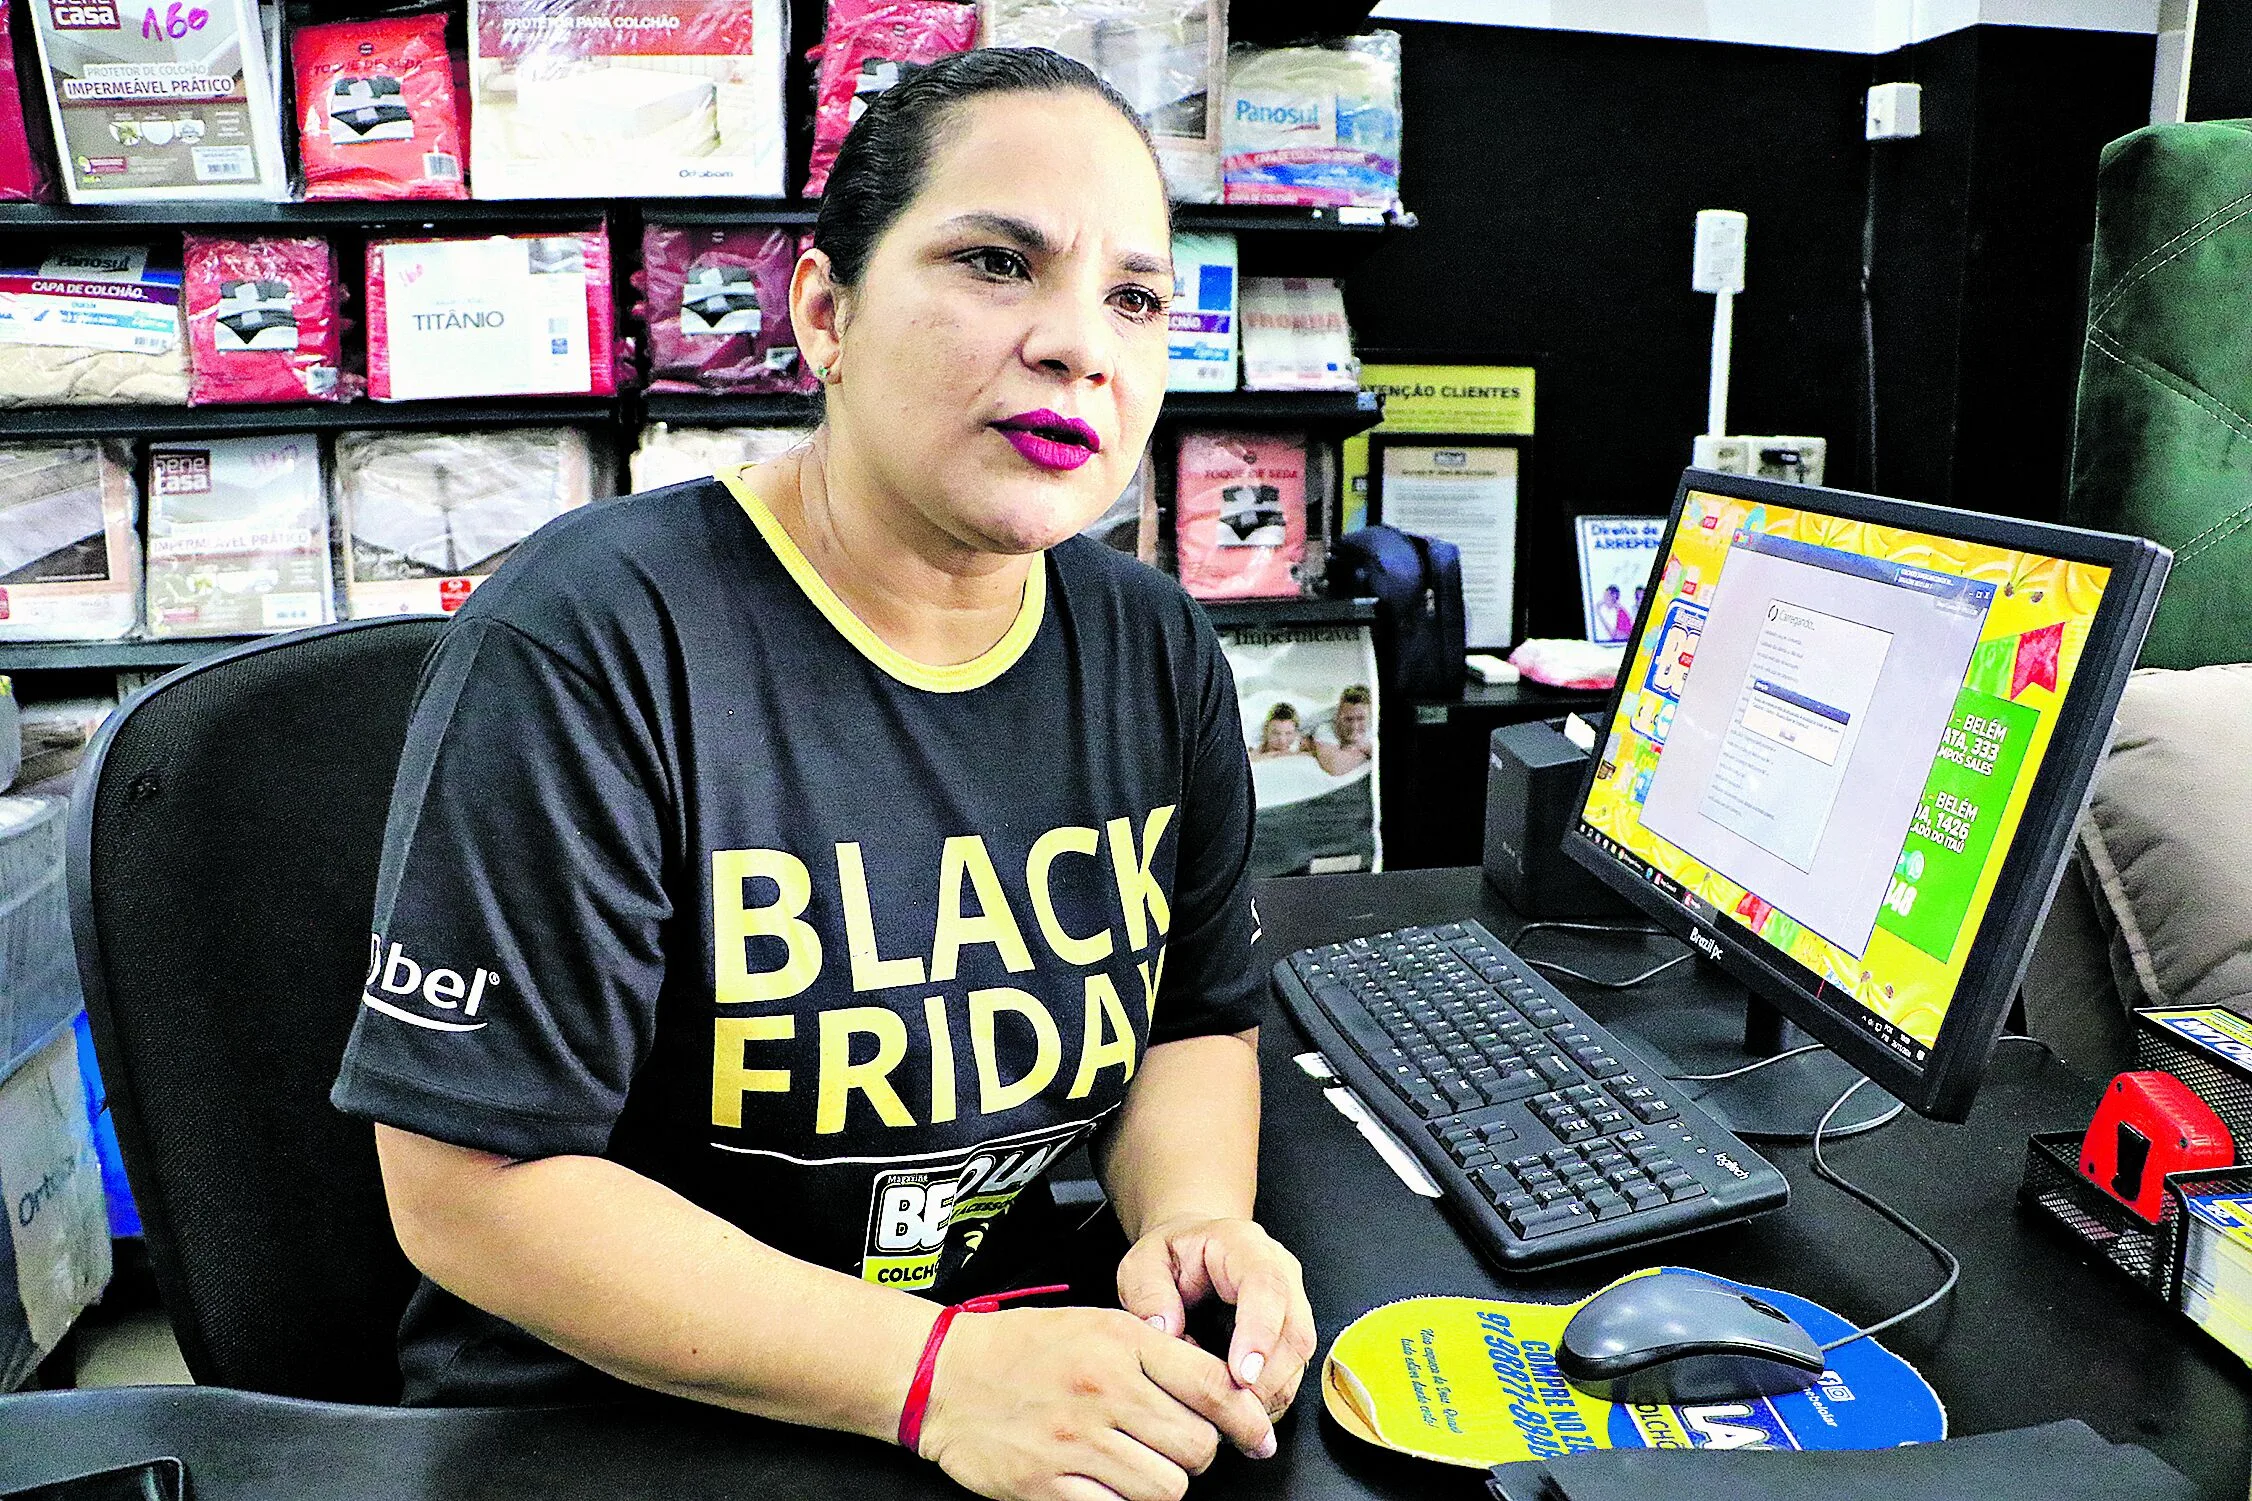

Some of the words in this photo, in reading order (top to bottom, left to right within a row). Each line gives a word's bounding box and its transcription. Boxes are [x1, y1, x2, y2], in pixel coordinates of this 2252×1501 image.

[54, 6, 117, 26] casa
[576, 16, 612, 28] PARA
[613, 14, 681, 30] COLCHÃO
[86, 65, 141, 78] PROTETOR
[143, 65, 155, 77] DE
[67, 77, 168, 96] IMPERMEÁVEL
[171, 76, 233, 93] PRÁTICO
[1235, 98, 1320, 125] Panosul
[31, 281, 66, 294] CAPA
[66, 284, 83, 295] DE
[412, 308, 505, 331] TITÂNIO
[1168, 313, 1201, 329] CHÃO
[1440, 386, 1522, 399] CLIENTES
[1963, 713, 2009, 744] BELÉM
[1970, 736, 2001, 763] 333
[1964, 755, 1995, 777] SALES
[1934, 790, 1980, 823] BELÉM
[1935, 811, 1972, 841] 1426
[1930, 831, 1946, 845] DO
[711, 804, 1177, 1005] BLACK
[1476, 1311, 1515, 1339] 91
[1520, 1340, 1576, 1408] COMPRE
[1548, 1411, 1588, 1432] NO
